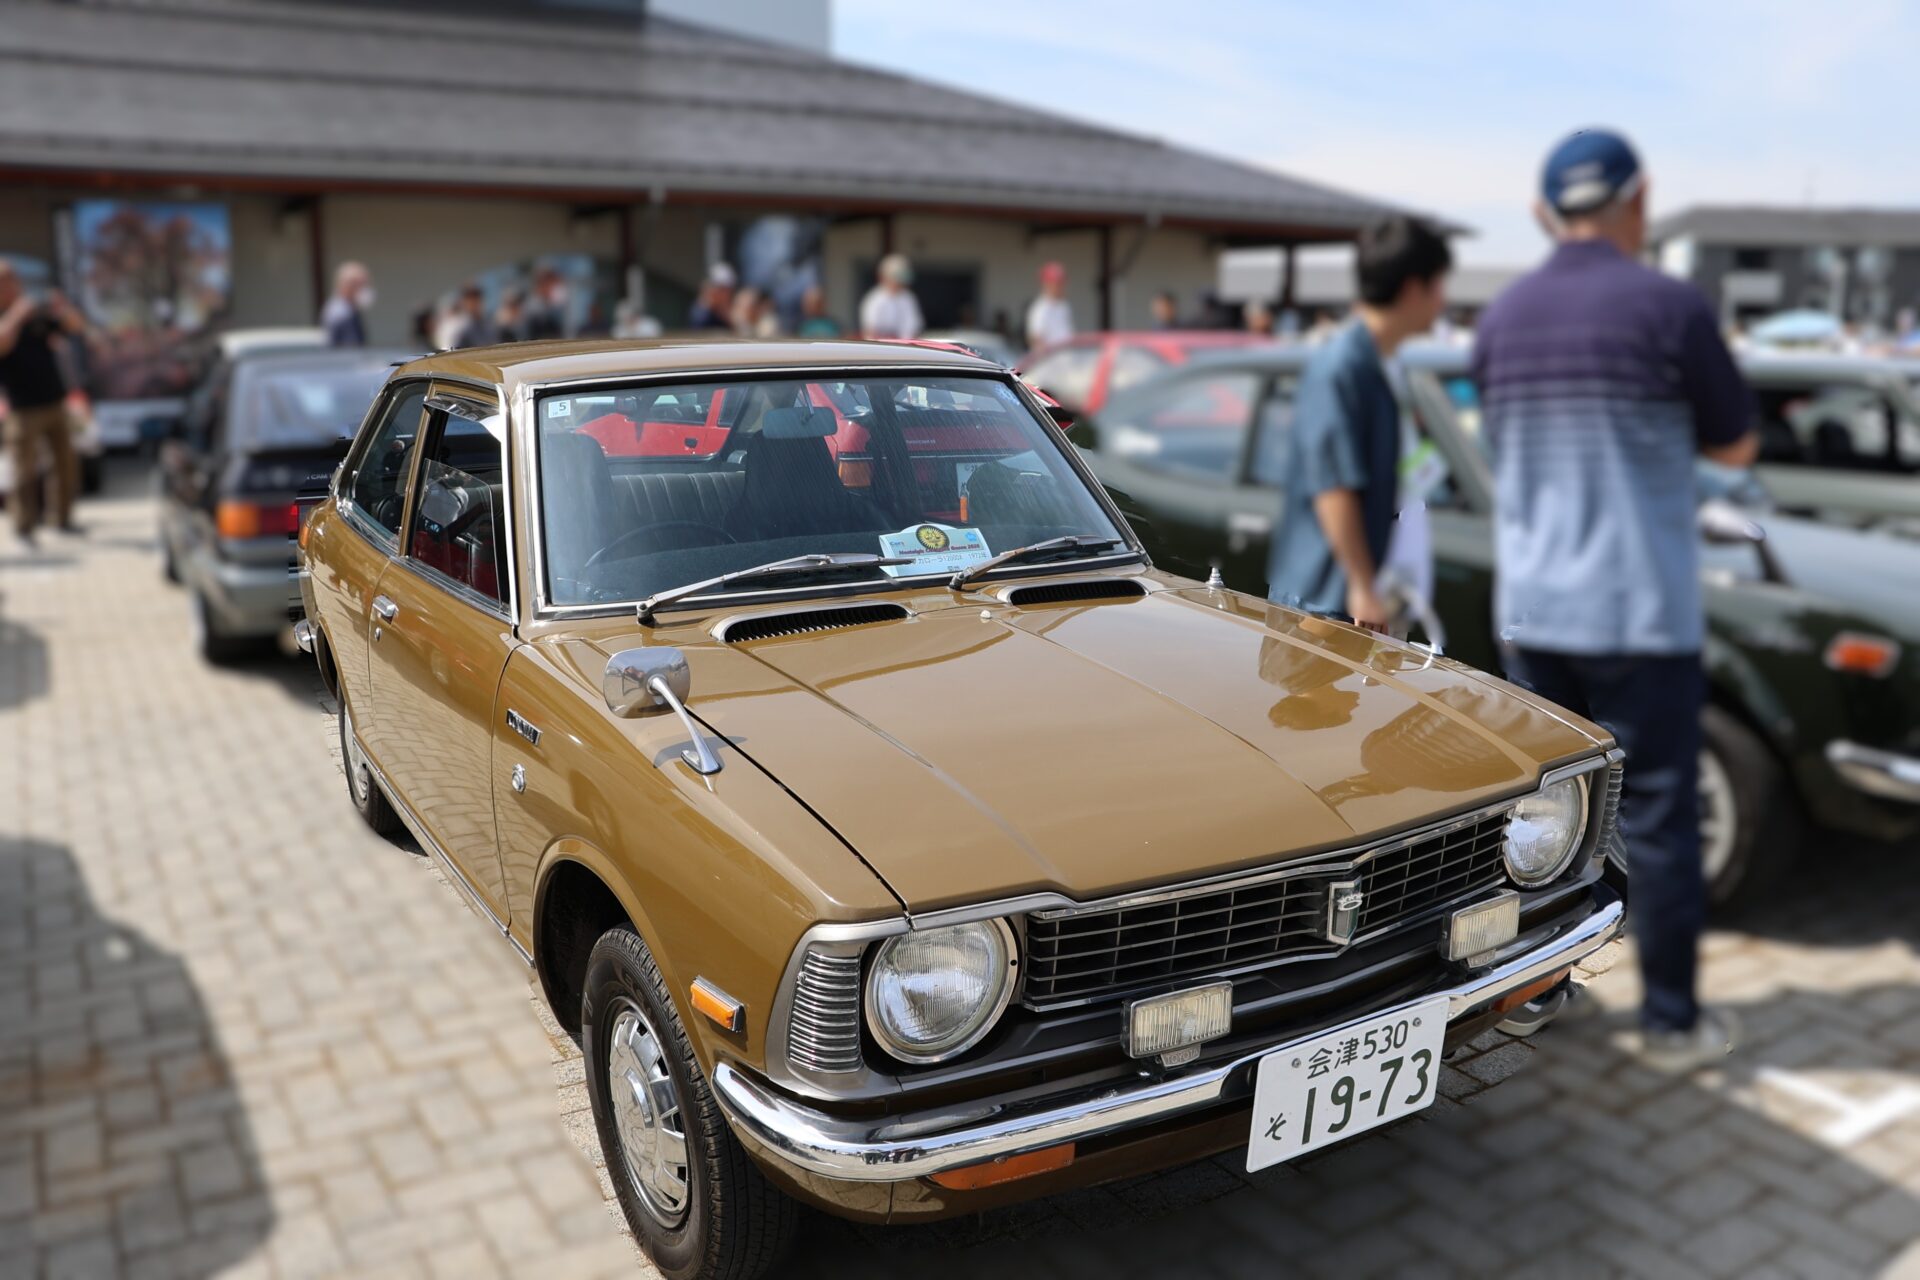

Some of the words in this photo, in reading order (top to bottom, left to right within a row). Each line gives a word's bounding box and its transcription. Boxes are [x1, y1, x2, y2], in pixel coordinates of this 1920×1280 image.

[559, 402, 567, 411] 5
[1166, 1047, 1198, 1064] TOYOTA
[1264, 1112, 1287, 1141] そ
[1302, 1048, 1432, 1145] 19-73
